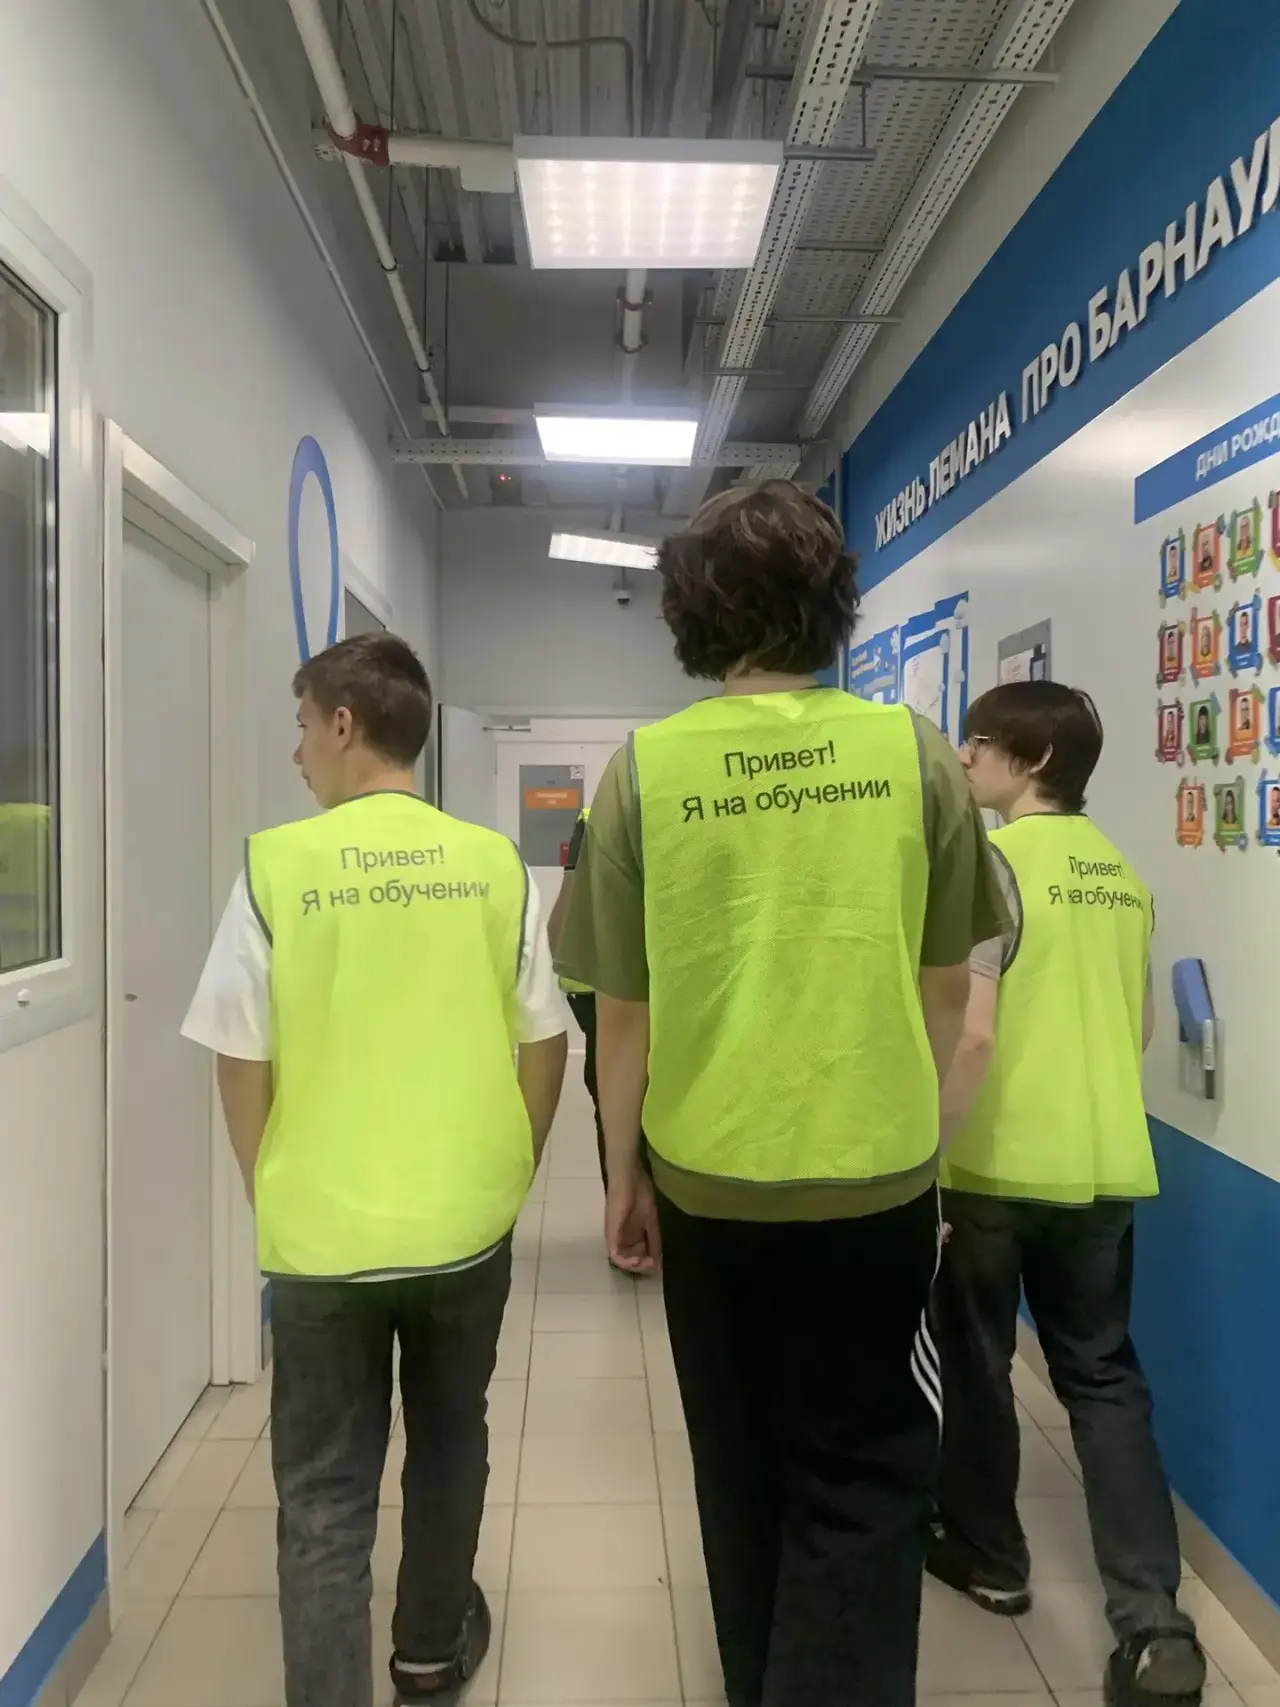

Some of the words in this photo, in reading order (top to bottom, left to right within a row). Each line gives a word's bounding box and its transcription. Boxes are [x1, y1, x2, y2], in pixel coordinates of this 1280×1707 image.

[875, 476, 926, 552] ЖИЗНЬ
[928, 390, 1012, 507] ЛЕМАНА
[1021, 322, 1081, 424] ПРО
[1195, 440, 1228, 482] ДНИ
[724, 740, 836, 780] Привет!
[682, 796, 704, 823] Я
[714, 796, 747, 817] на
[756, 779, 891, 814] обучении
[340, 844, 445, 873] Привет!
[302, 889, 321, 916] Я
[330, 887, 360, 908] на
[1048, 885, 1063, 905] Я
